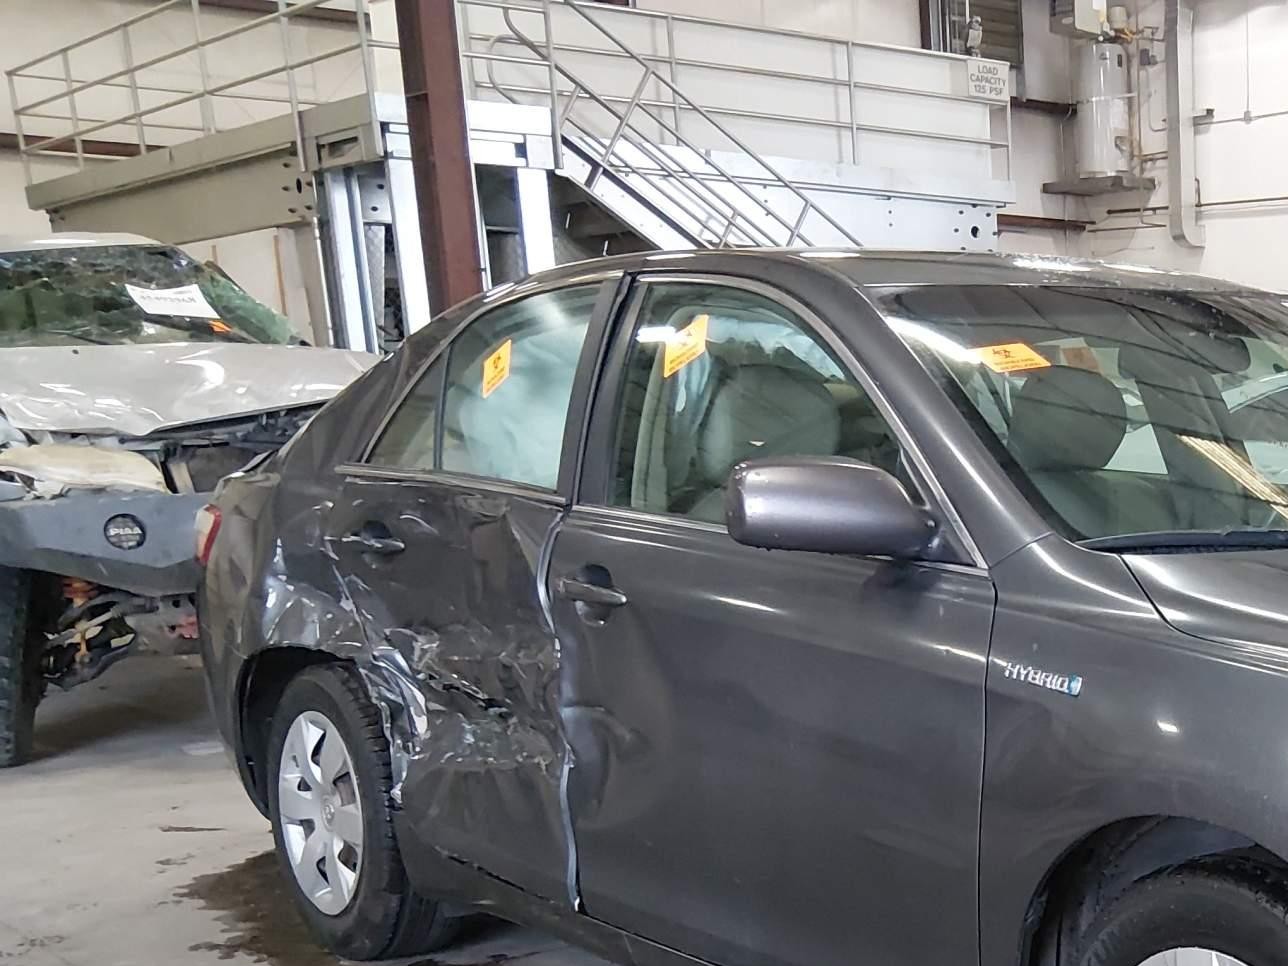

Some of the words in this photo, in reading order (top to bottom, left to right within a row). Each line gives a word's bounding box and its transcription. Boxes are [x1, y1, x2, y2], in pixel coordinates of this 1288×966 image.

[977, 64, 999, 76] LOAD
[970, 73, 1007, 88] CAPACITY
[989, 86, 1005, 97] PSF
[1004, 662, 1069, 692] HYBRID
